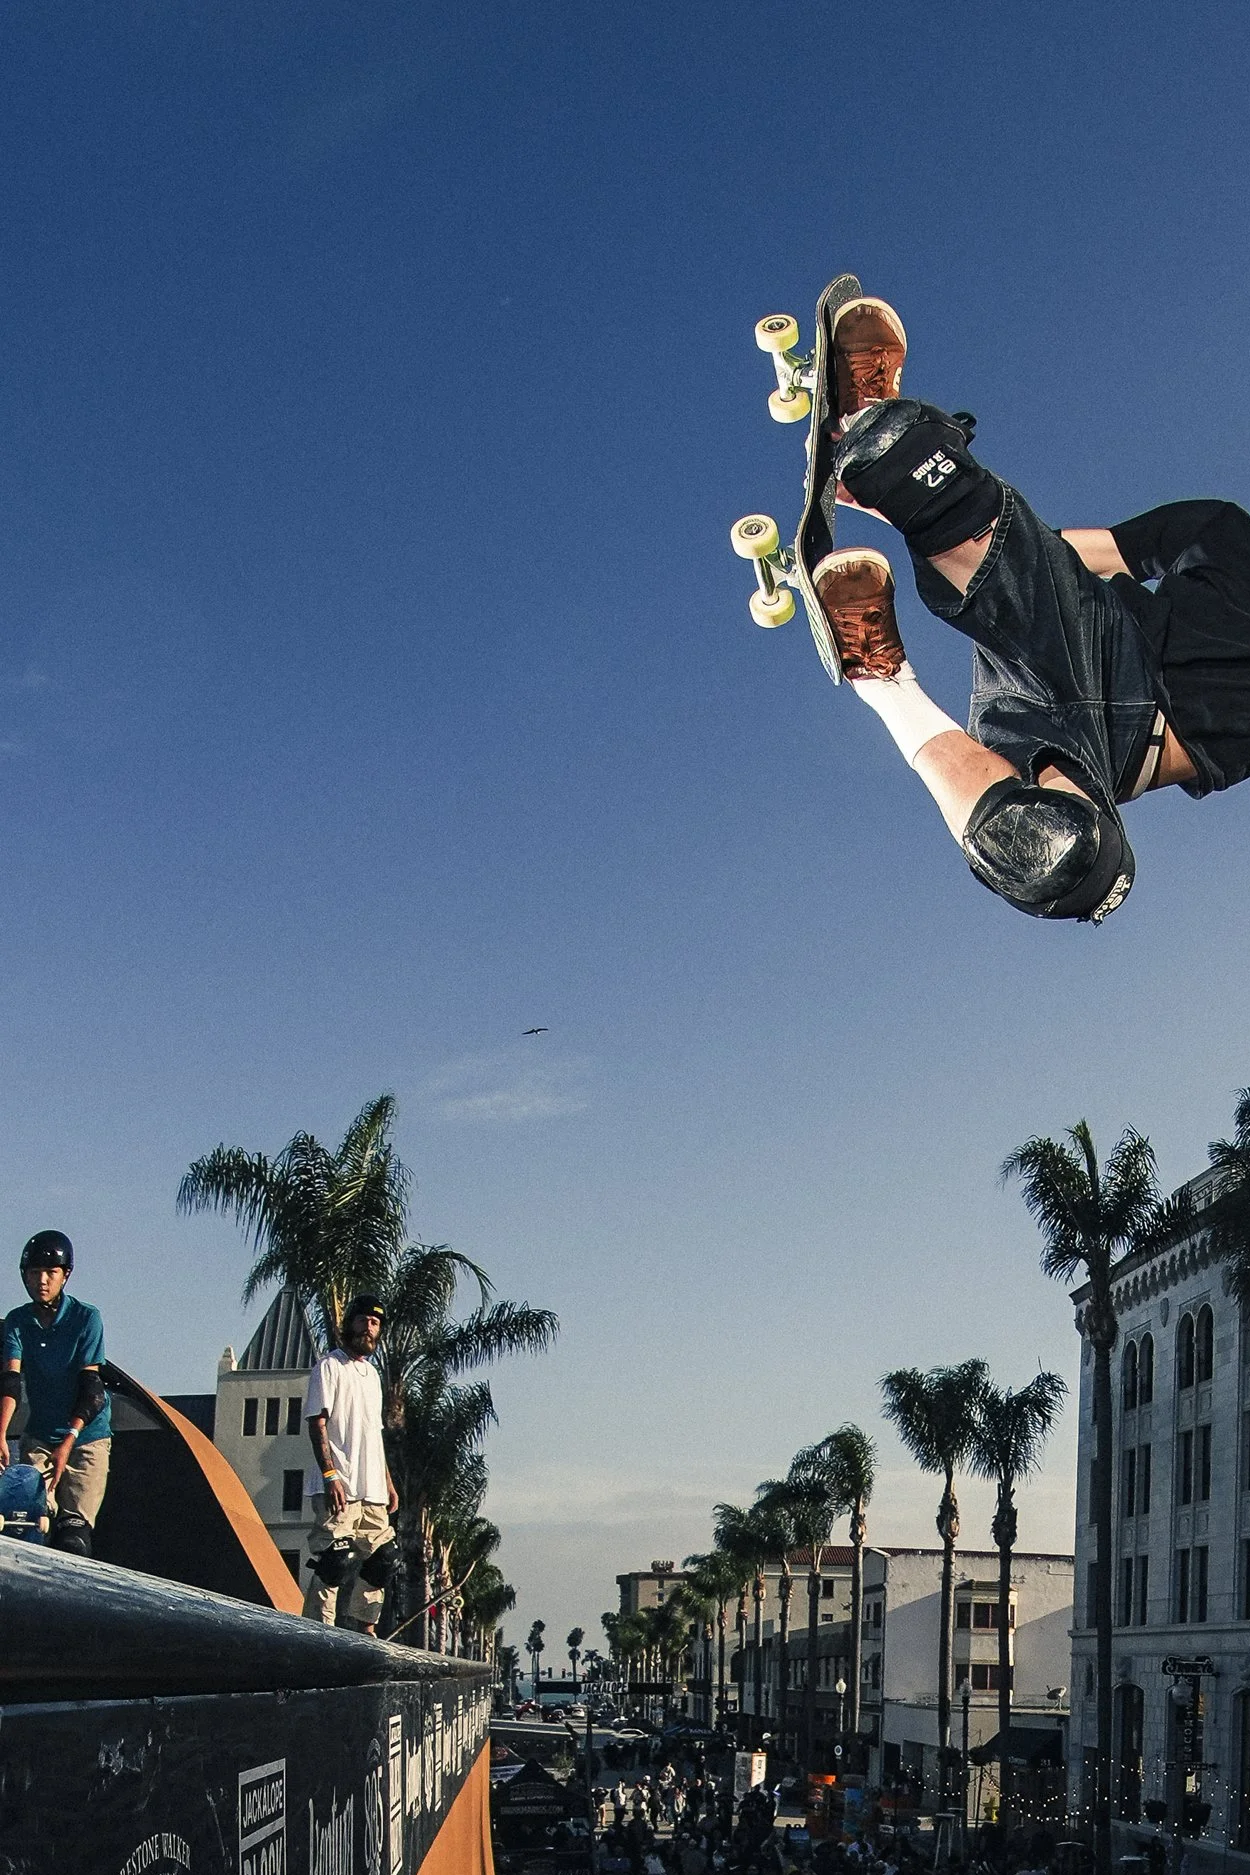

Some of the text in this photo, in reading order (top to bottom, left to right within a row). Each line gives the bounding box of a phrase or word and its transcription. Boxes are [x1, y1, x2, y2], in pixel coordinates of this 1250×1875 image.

[926, 458, 957, 488] 87
[243, 1779, 283, 1829] JACKALOPE
[365, 1765, 384, 1869] 805
[161, 1832, 191, 1871] WALKER
